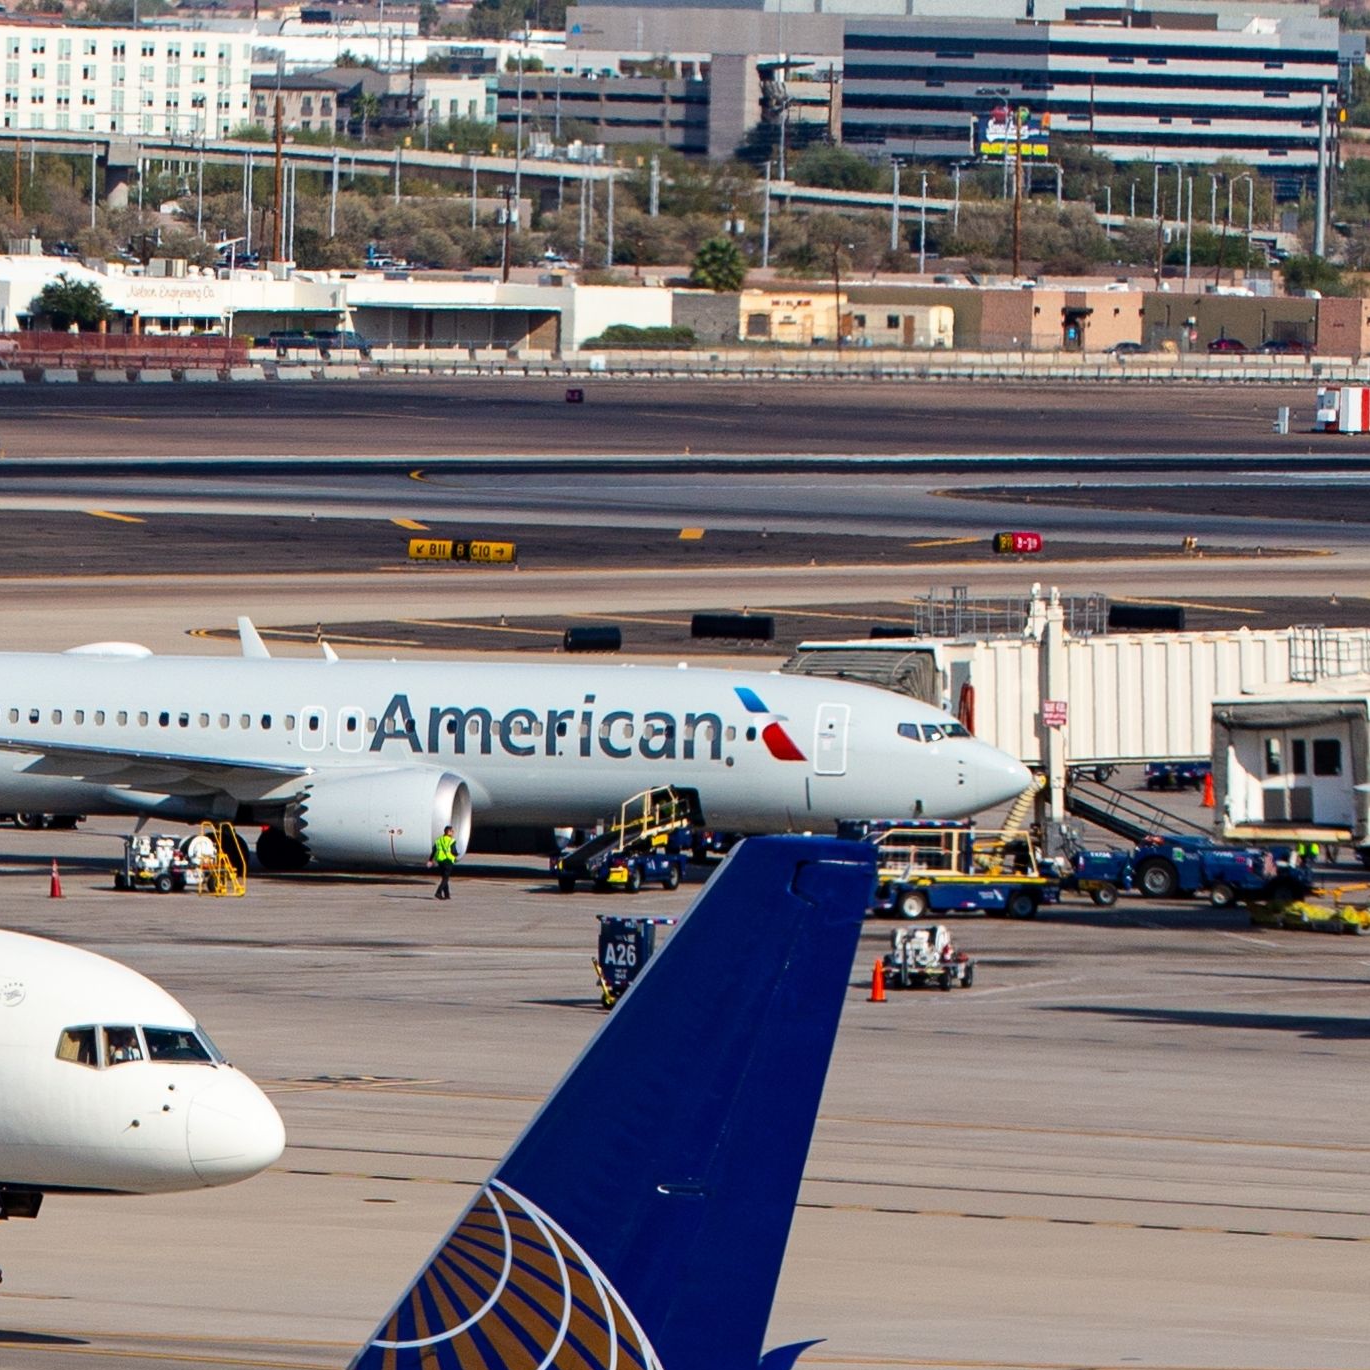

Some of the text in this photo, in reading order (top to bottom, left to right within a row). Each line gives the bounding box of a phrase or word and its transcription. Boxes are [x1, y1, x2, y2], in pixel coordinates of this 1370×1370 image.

[429, 543, 446, 557] B11
[471, 545, 490, 557] C10
[369, 693, 723, 760] American
[604, 942, 637, 966] A26
